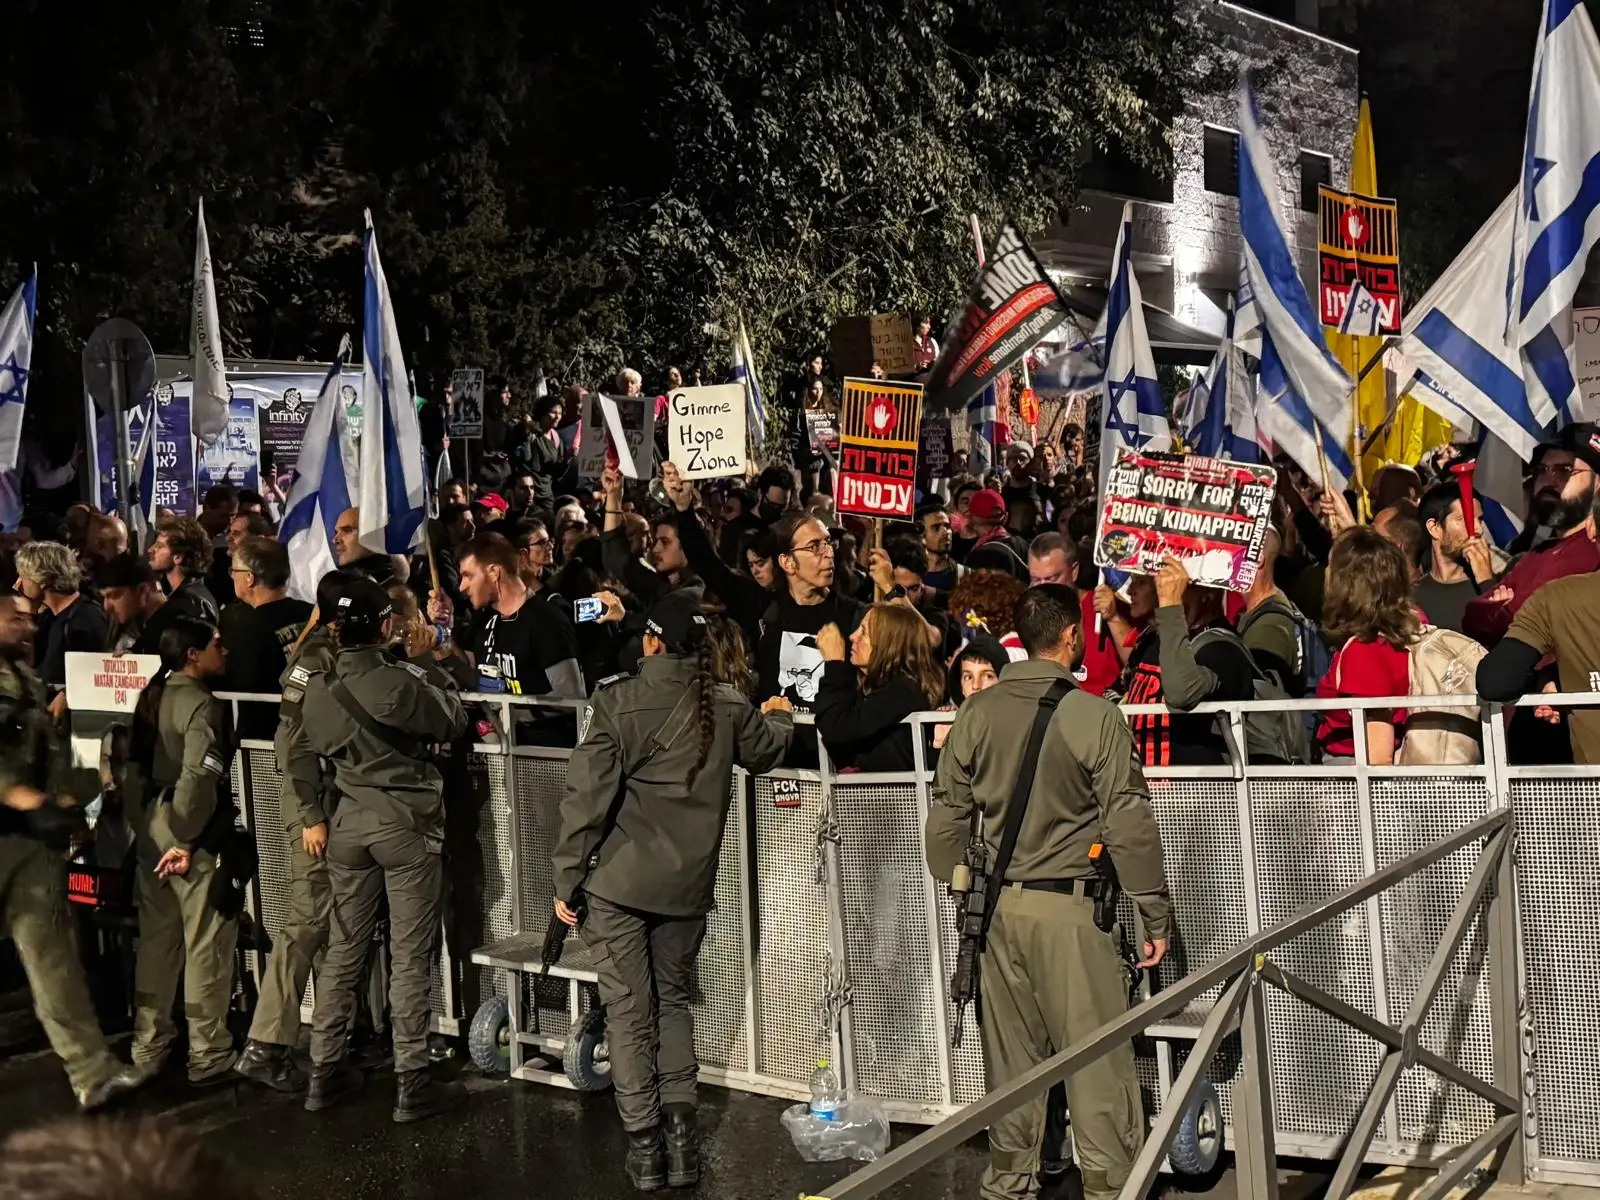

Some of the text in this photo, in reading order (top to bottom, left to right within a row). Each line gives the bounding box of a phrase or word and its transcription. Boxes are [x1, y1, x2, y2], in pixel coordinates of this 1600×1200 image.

[1322, 257, 1397, 291] בחירות
[1325, 286, 1396, 328] עיו!
[269, 410, 308, 422] infinity
[673, 393, 731, 415] Gimme
[681, 425, 724, 451] Hope
[688, 448, 738, 471] Ziona
[842, 448, 914, 476] בחירות
[842, 476, 912, 513] עכשיו!
[1142, 475, 1199, 501] SORRY
[1201, 484, 1235, 508] FOR
[1111, 501, 1254, 540] BEING KIDNAPPED
[94, 674, 113, 688] MATAN
[115, 690, 127, 705] (24)
[773, 780, 799, 793] FCK
